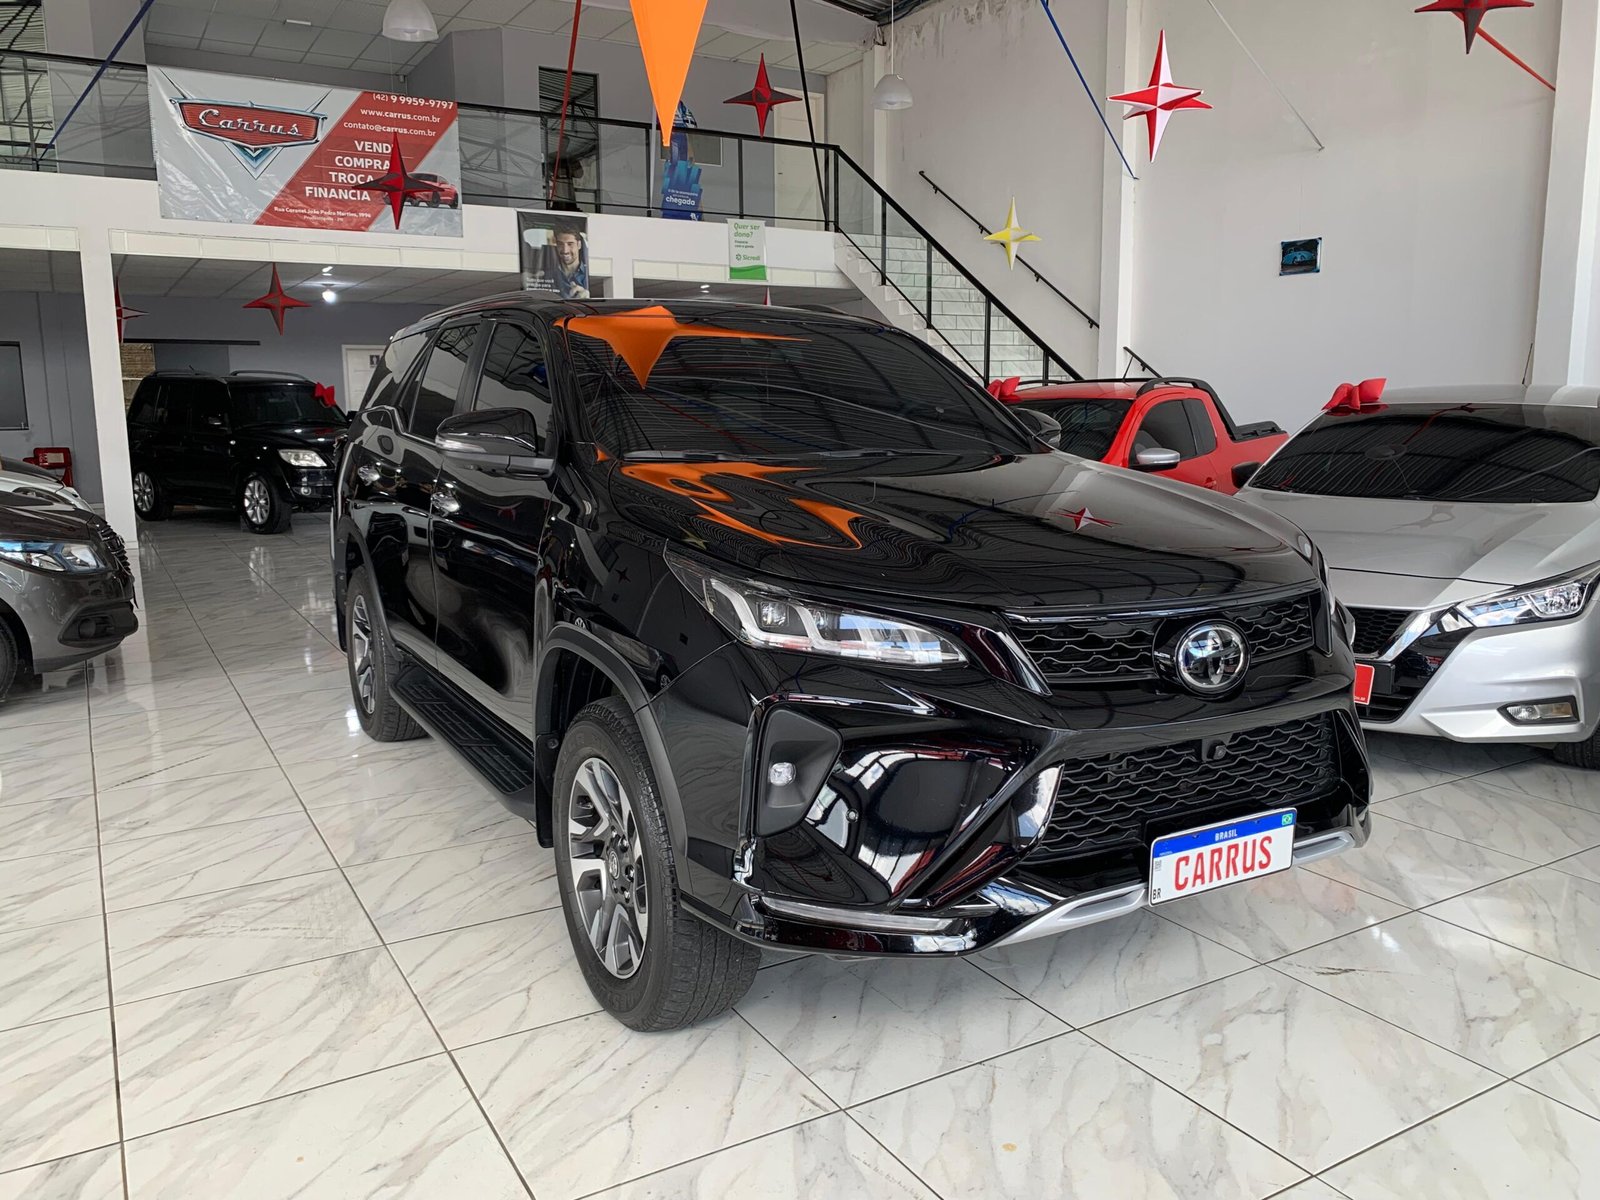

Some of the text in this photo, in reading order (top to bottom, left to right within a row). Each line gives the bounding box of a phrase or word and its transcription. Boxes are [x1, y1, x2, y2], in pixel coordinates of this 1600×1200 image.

[373, 93, 454, 110] (42) 9 9959-9797
[198, 108, 303, 137] Carrus
[360, 108, 441, 123] www.carrus.com.br
[343, 121, 437, 137] contato@carrus.com.br
[354, 140, 393, 154] VEND
[335, 156, 391, 170] COMPRA
[328, 171, 375, 185] TROCA
[305, 186, 372, 201] FINANCIA
[665, 195, 696, 206] chegada
[733, 222, 749, 230] Quer
[1214, 828, 1238, 842] BRASIL
[1174, 835, 1273, 891] CARRUS
[1152, 888, 1162, 900] BR
